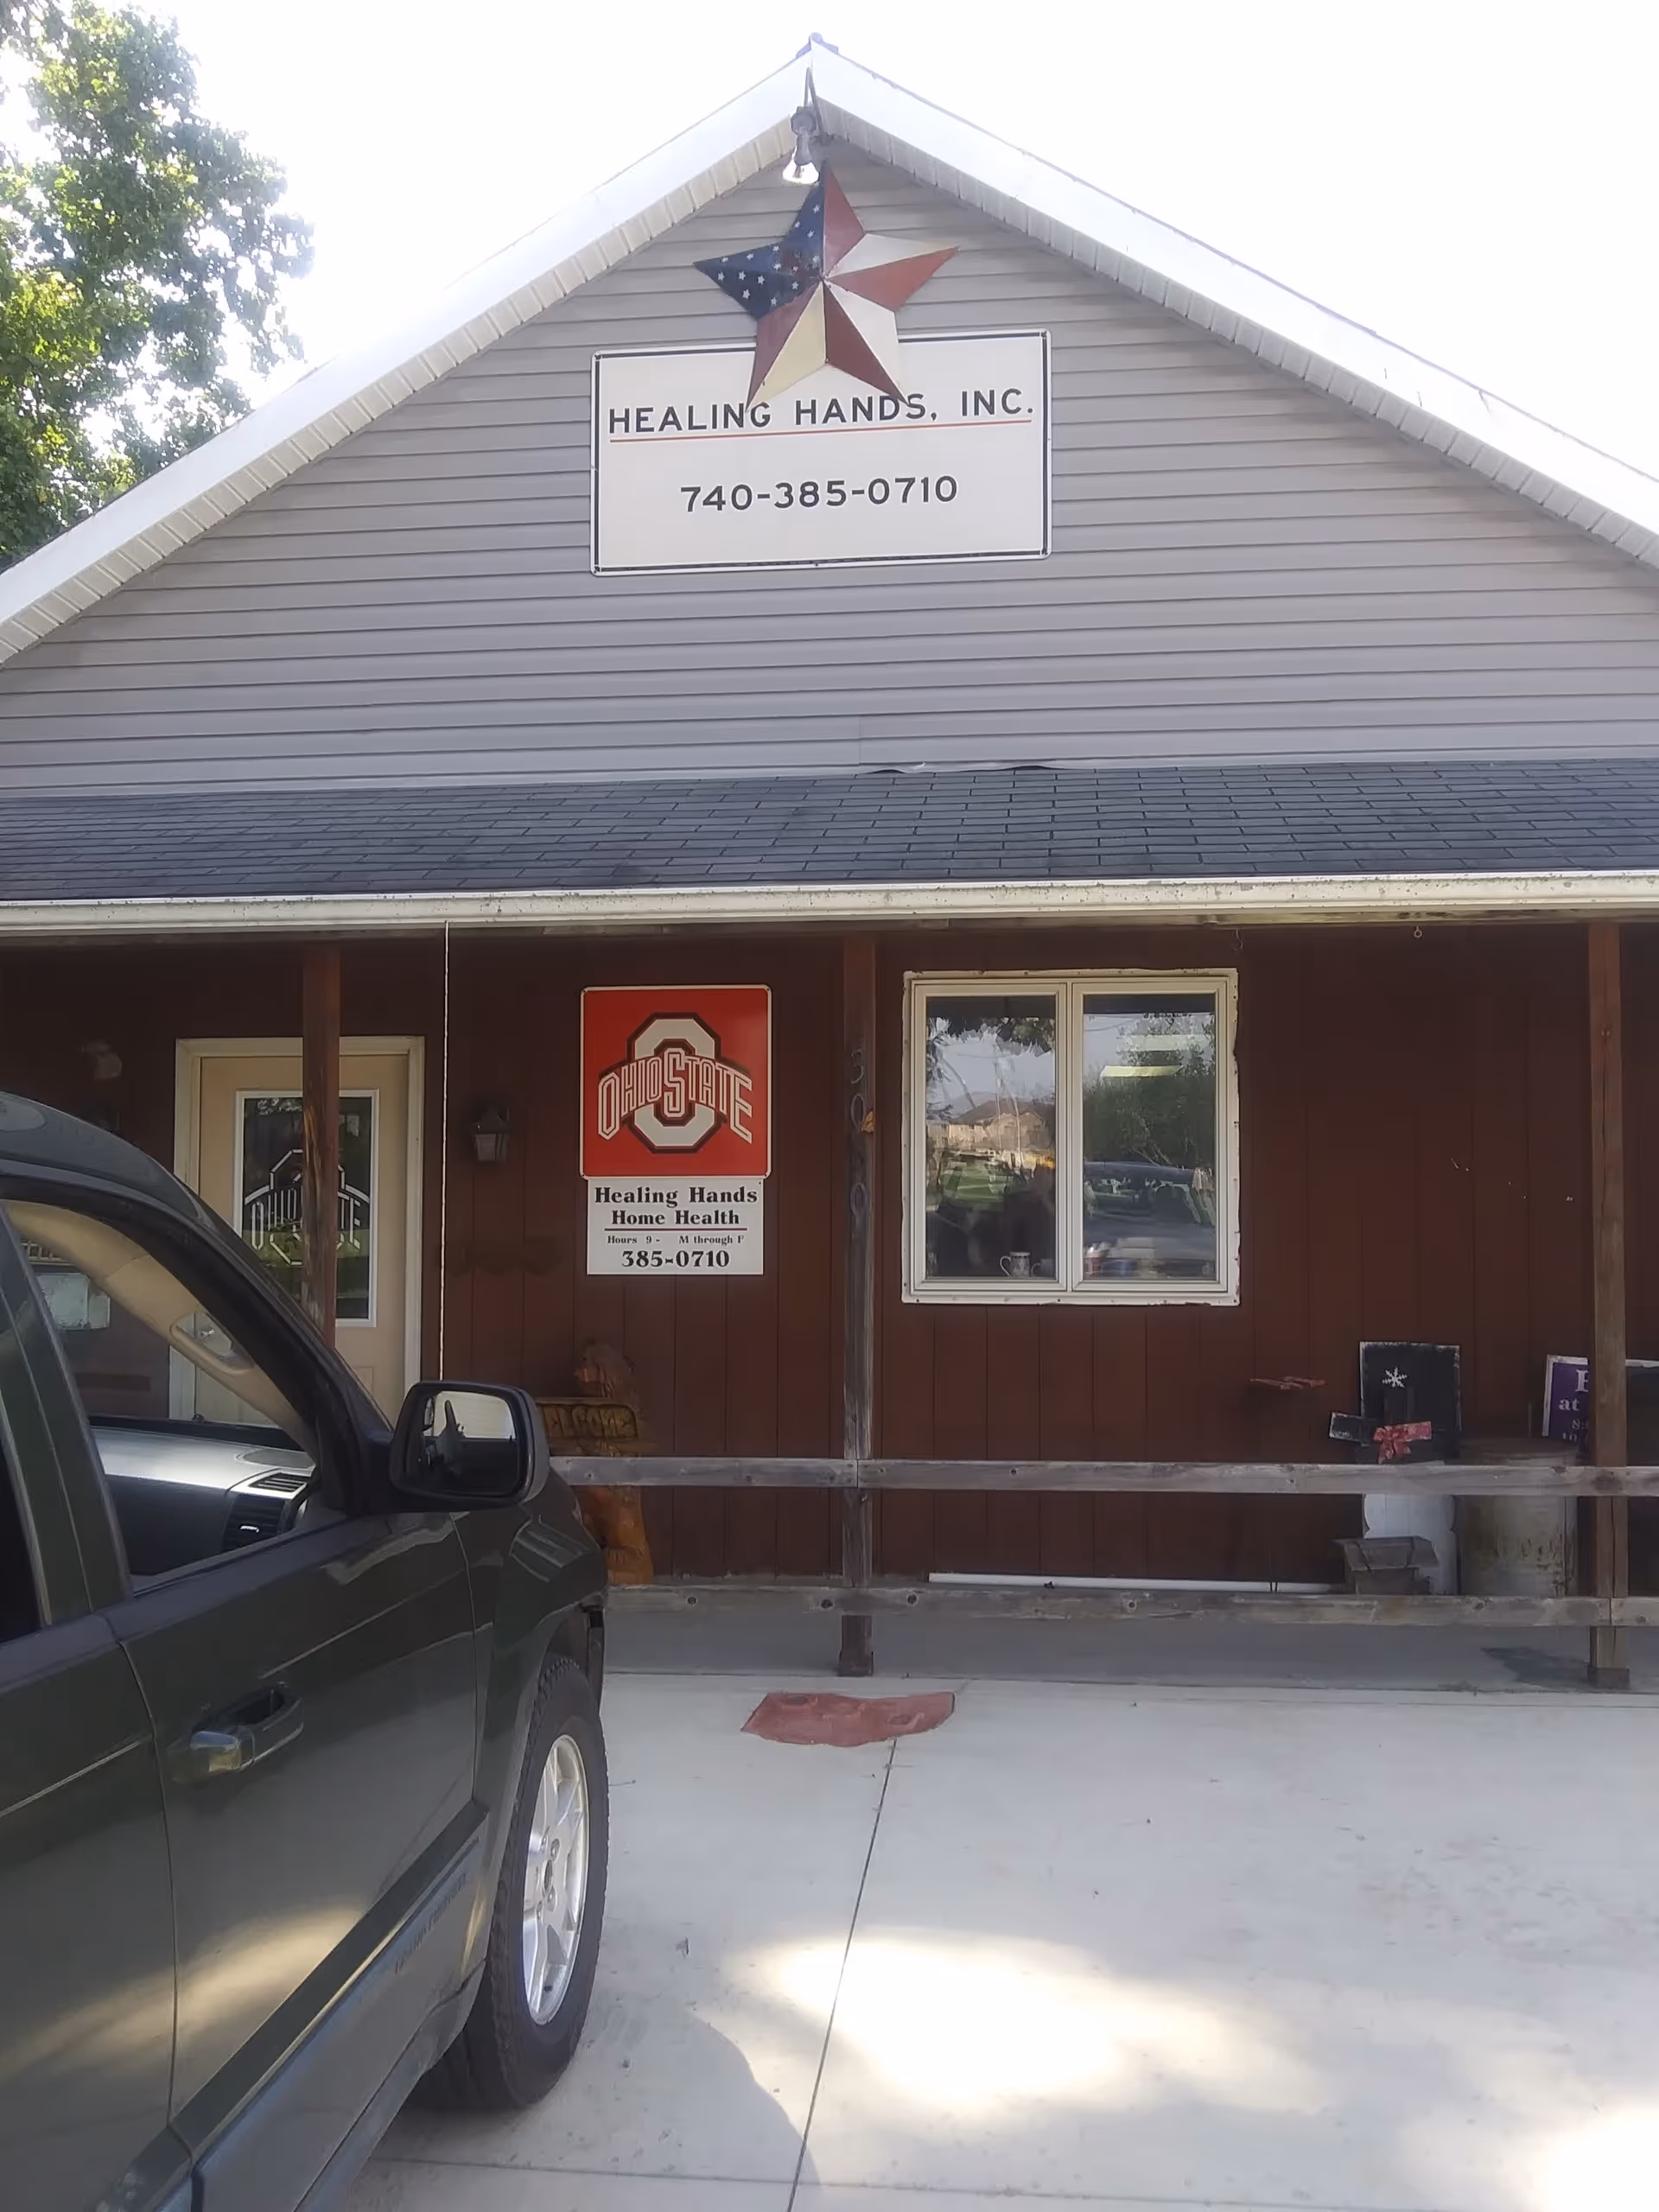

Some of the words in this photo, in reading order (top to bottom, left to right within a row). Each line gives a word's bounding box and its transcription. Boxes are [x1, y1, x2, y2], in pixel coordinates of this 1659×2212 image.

[609, 401, 771, 434] HEALING
[795, 392, 938, 426] HANDS,
[962, 388, 1034, 417] INC.
[680, 475, 958, 512] 740-385-0710
[597, 1056, 662, 1141] OHIO
[664, 1047, 753, 1145] STATE
[594, 1186, 678, 1209] Healing
[689, 1186, 759, 1204] Hands
[611, 1210, 665, 1225] Home
[675, 1210, 741, 1225] Health
[607, 1235, 638, 1245] Hours
[645, 1235, 652, 1245] 9
[678, 1235, 690, 1244] M
[693, 1235, 734, 1247] through
[737, 1235, 745, 1244] F
[621, 1250, 730, 1268] 385-0710
[1558, 1397, 1580, 1412] at
